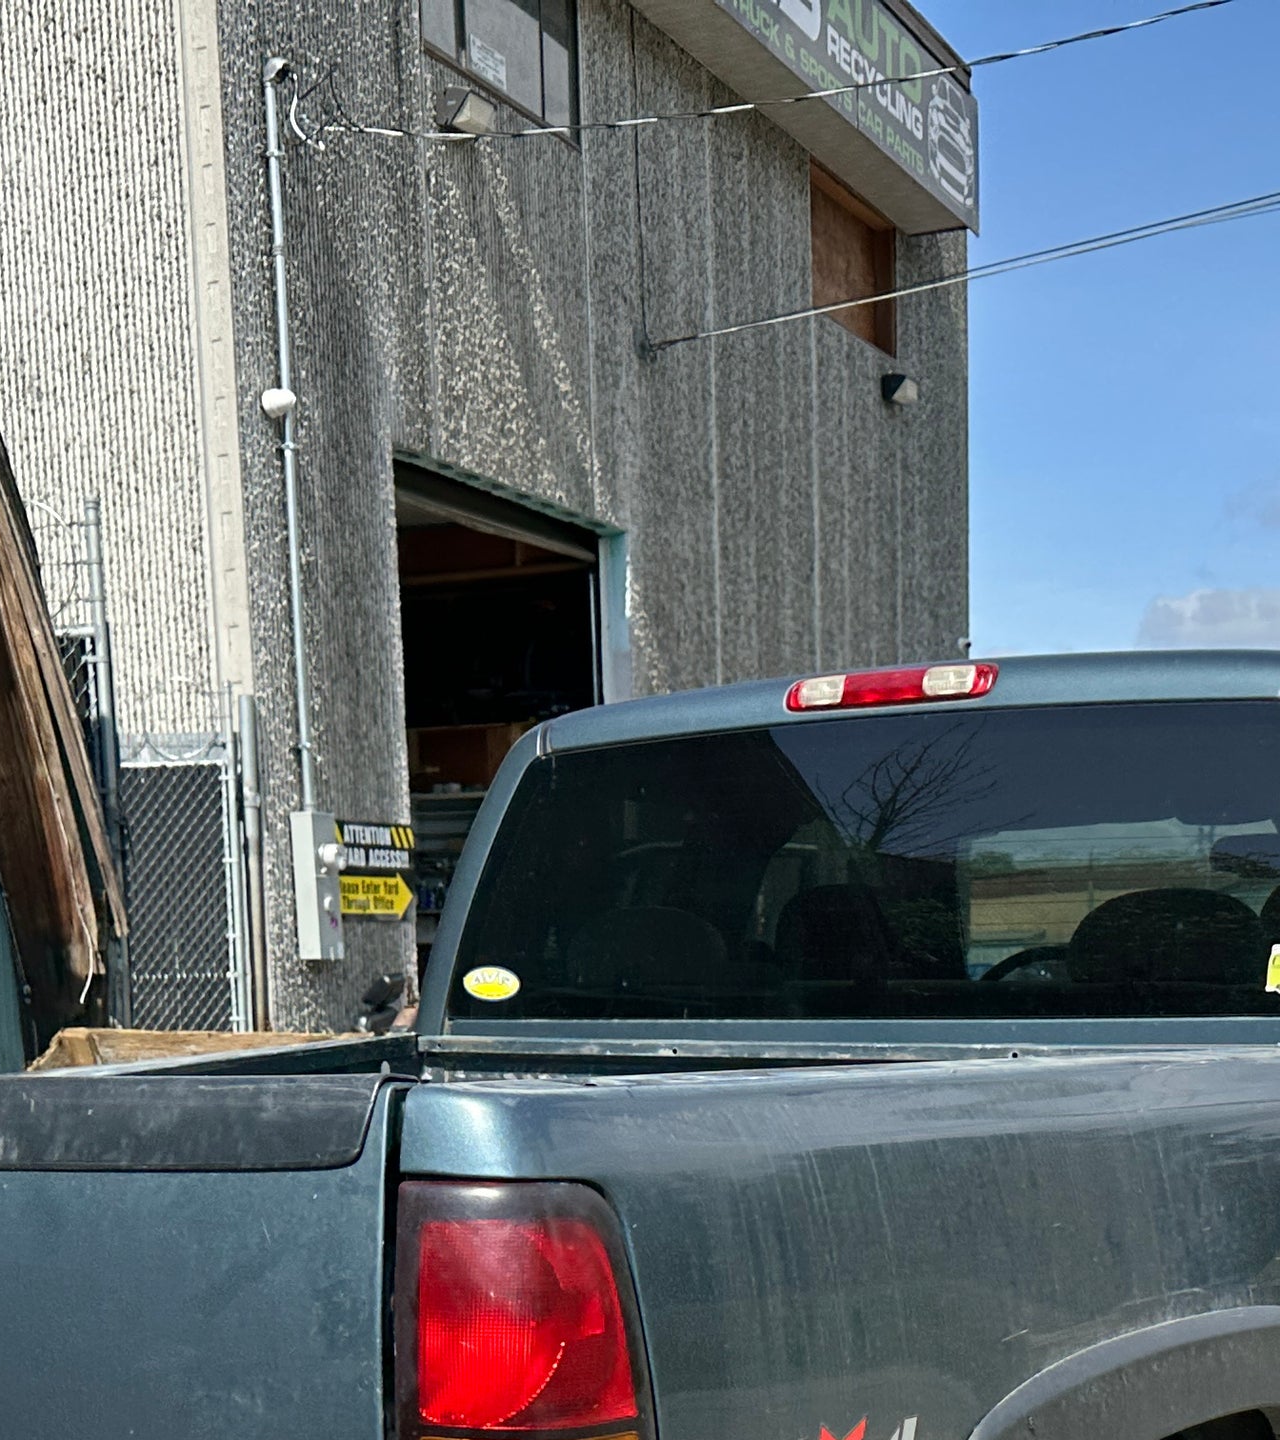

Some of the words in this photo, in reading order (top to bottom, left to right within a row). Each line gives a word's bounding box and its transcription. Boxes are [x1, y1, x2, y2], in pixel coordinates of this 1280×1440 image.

[826, 0, 922, 104] AUTO
[826, 24, 923, 140] RECYCLING
[784, 33, 796, 61] &
[858, 100, 883, 139] CAR
[886, 126, 924, 175] PARTS
[344, 824, 392, 846] ATTENTION
[345, 847, 366, 868] ARD
[361, 880, 381, 894] Enter
[383, 881, 399, 895] Yard
